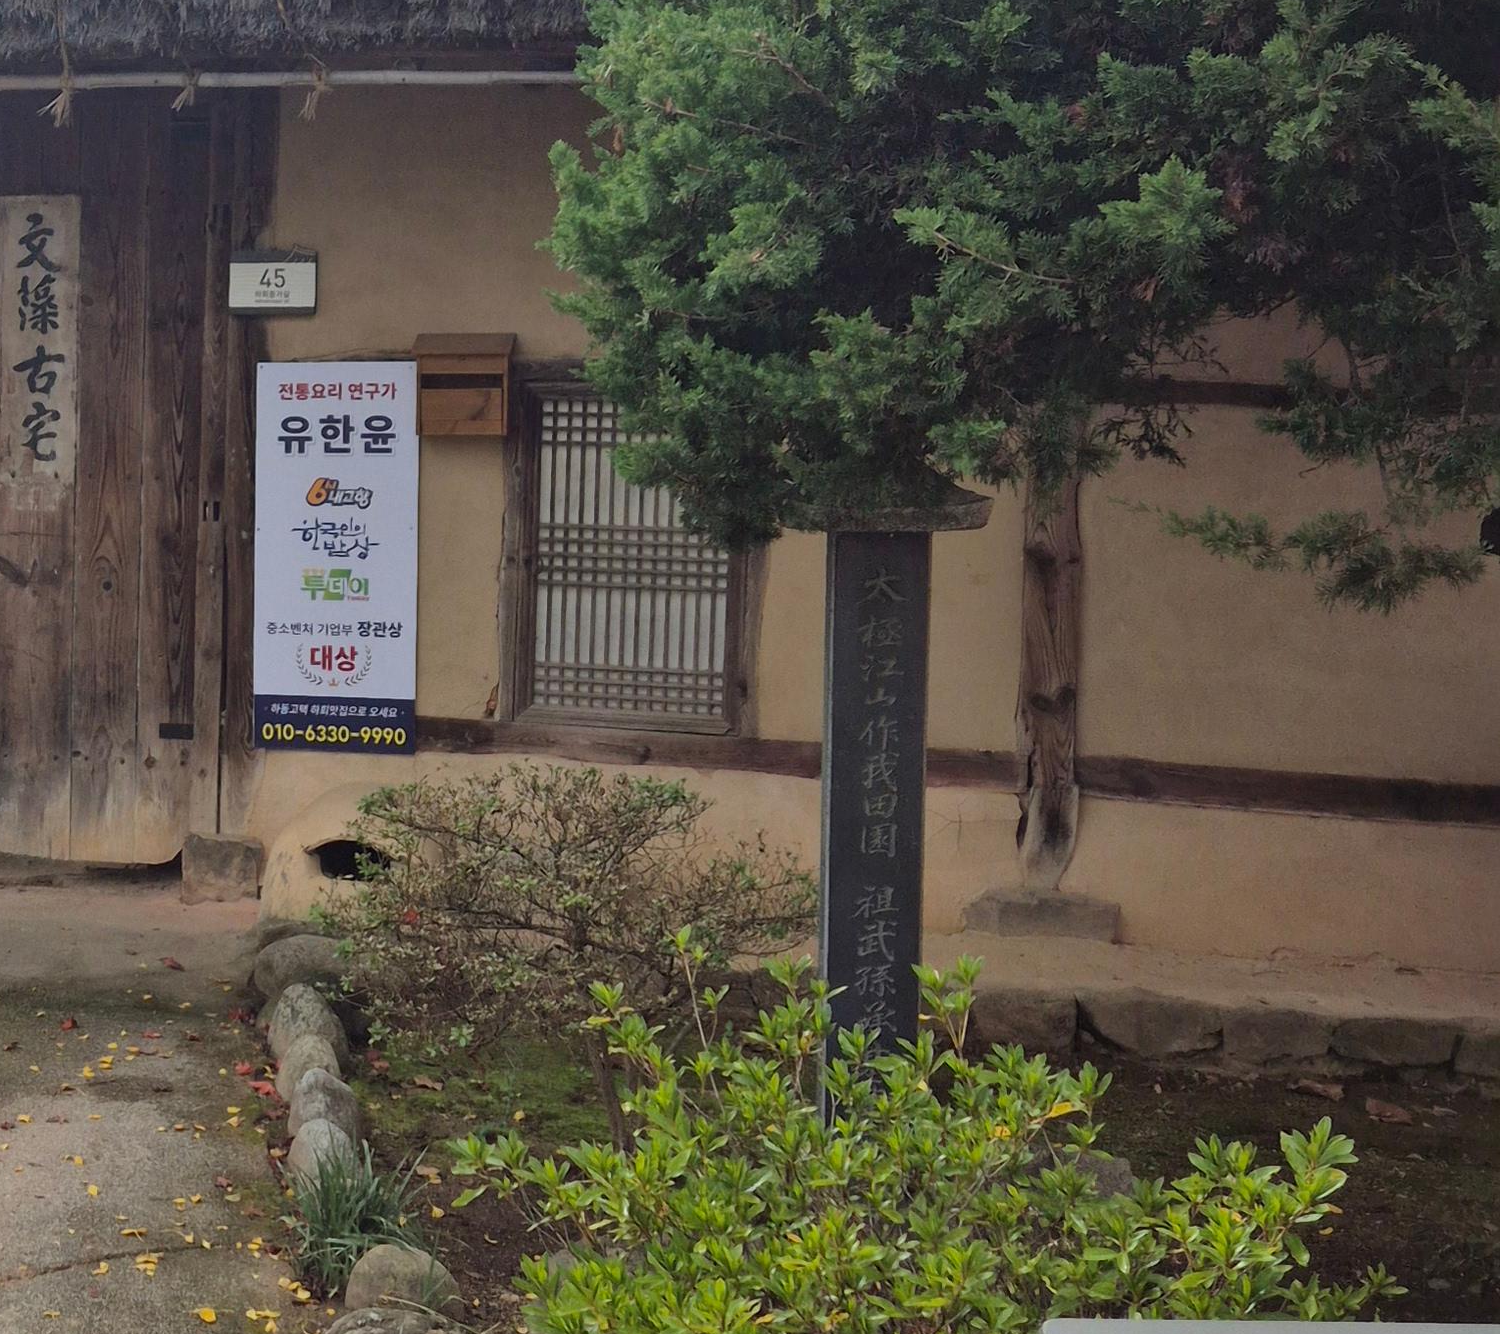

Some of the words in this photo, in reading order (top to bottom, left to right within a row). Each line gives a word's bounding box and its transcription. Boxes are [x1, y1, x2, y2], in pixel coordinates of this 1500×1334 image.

[259, 268, 286, 288] 45
[278, 382, 343, 401] 전통요리
[348, 382, 398, 400] 연구가
[277, 414, 397, 455] 유한윤
[291, 516, 367, 550] 한국인의
[323, 536, 380, 560] 밥상
[300, 573, 369, 601] 투데이
[266, 621, 314, 636] 중소벤처
[317, 623, 353, 636] 기업부
[357, 620, 404, 638] 장관상
[310, 645, 358, 672] 대상
[270, 703, 308, 715] 하동고택
[310, 704, 367, 717] 하회맛집으로
[369, 707, 398, 718] 오세요
[261, 723, 406, 746] 010-6330-9990
